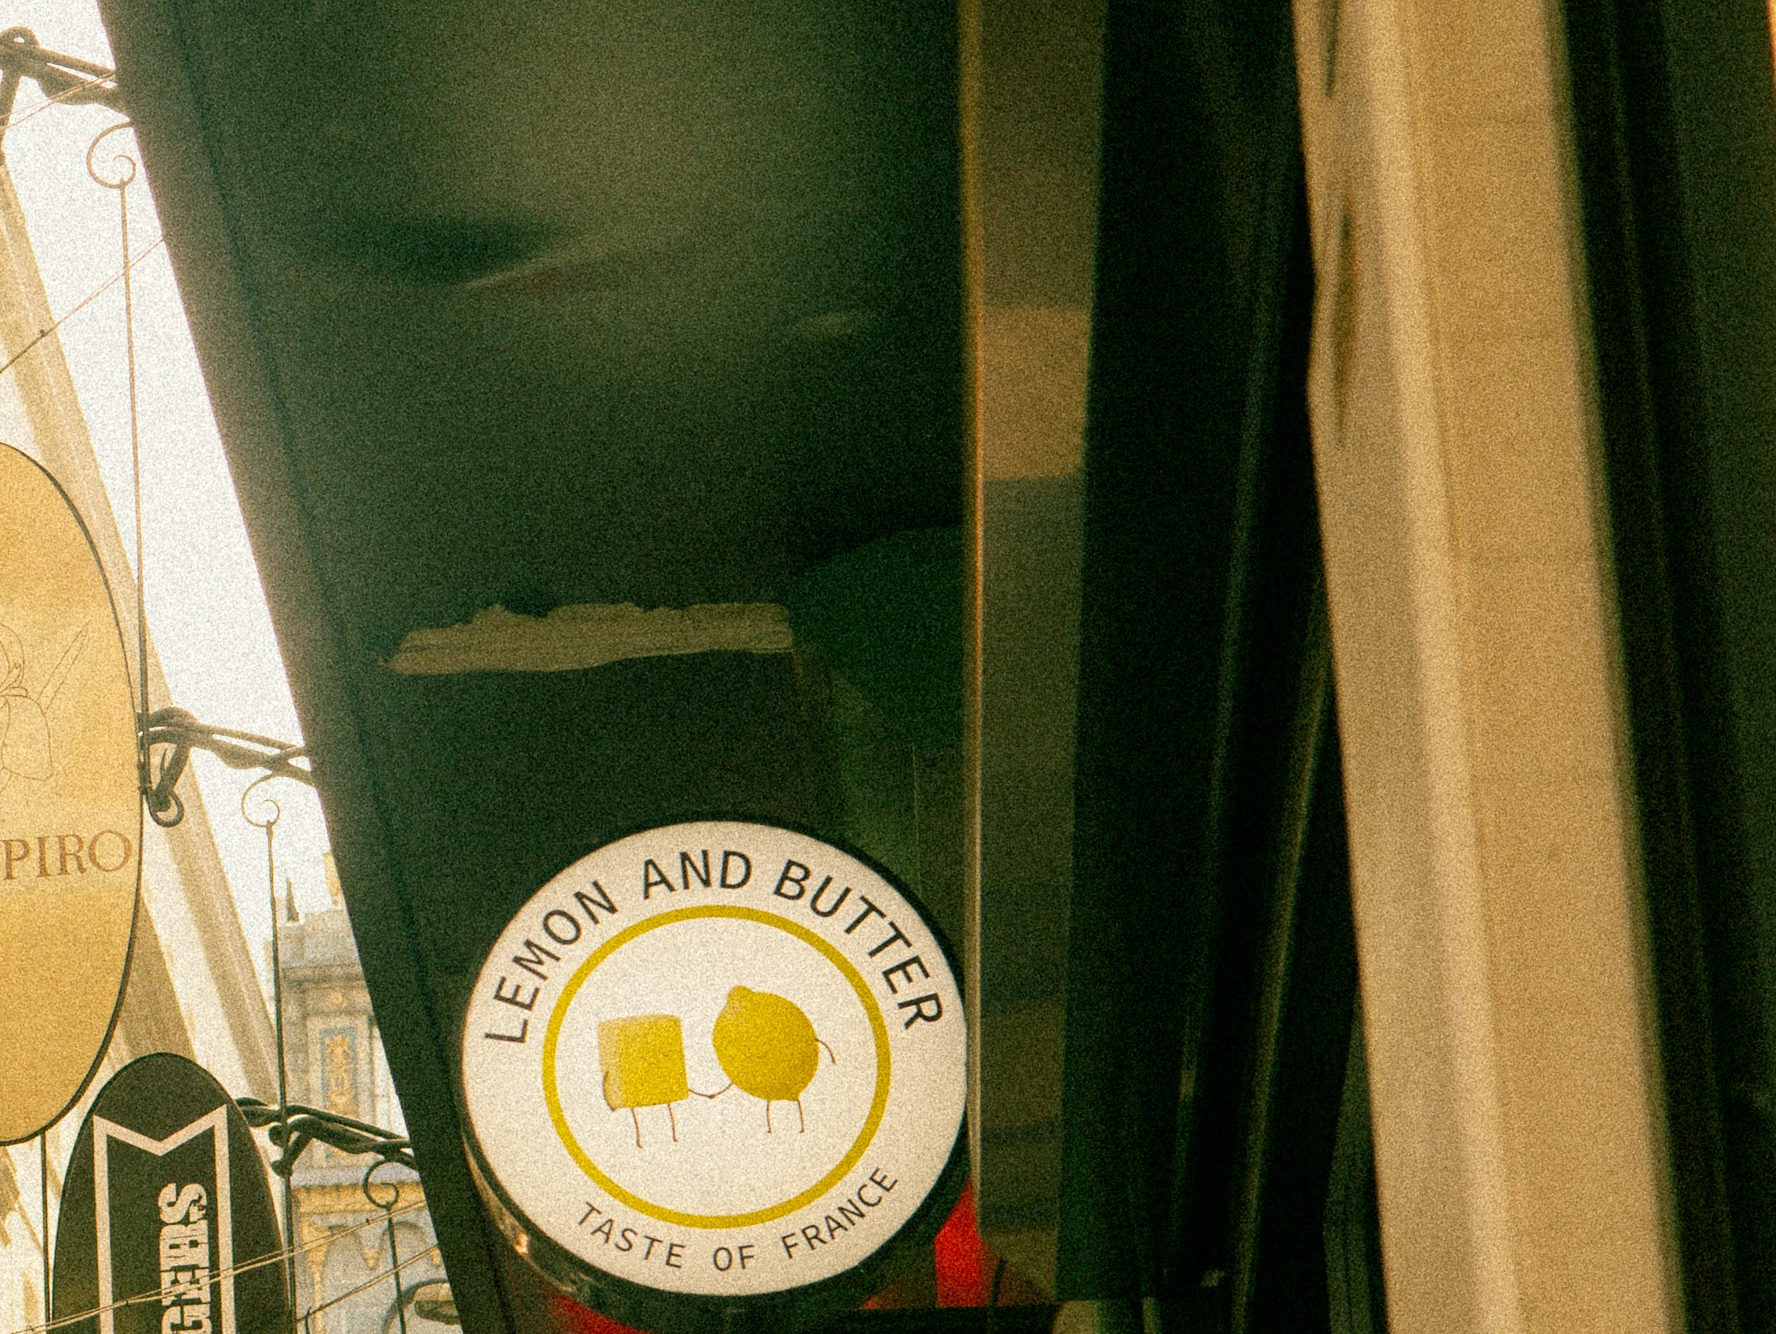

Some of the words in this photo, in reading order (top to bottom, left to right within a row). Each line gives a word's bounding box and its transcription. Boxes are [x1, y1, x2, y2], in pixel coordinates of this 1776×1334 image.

[484, 880, 619, 1045] LEMON
[642, 848, 753, 900] AND
[773, 859, 943, 1031] BUTTER
[576, 1201, 684, 1270] TASTE
[712, 1244, 757, 1272] OF
[781, 1167, 899, 1260] FRANCE
